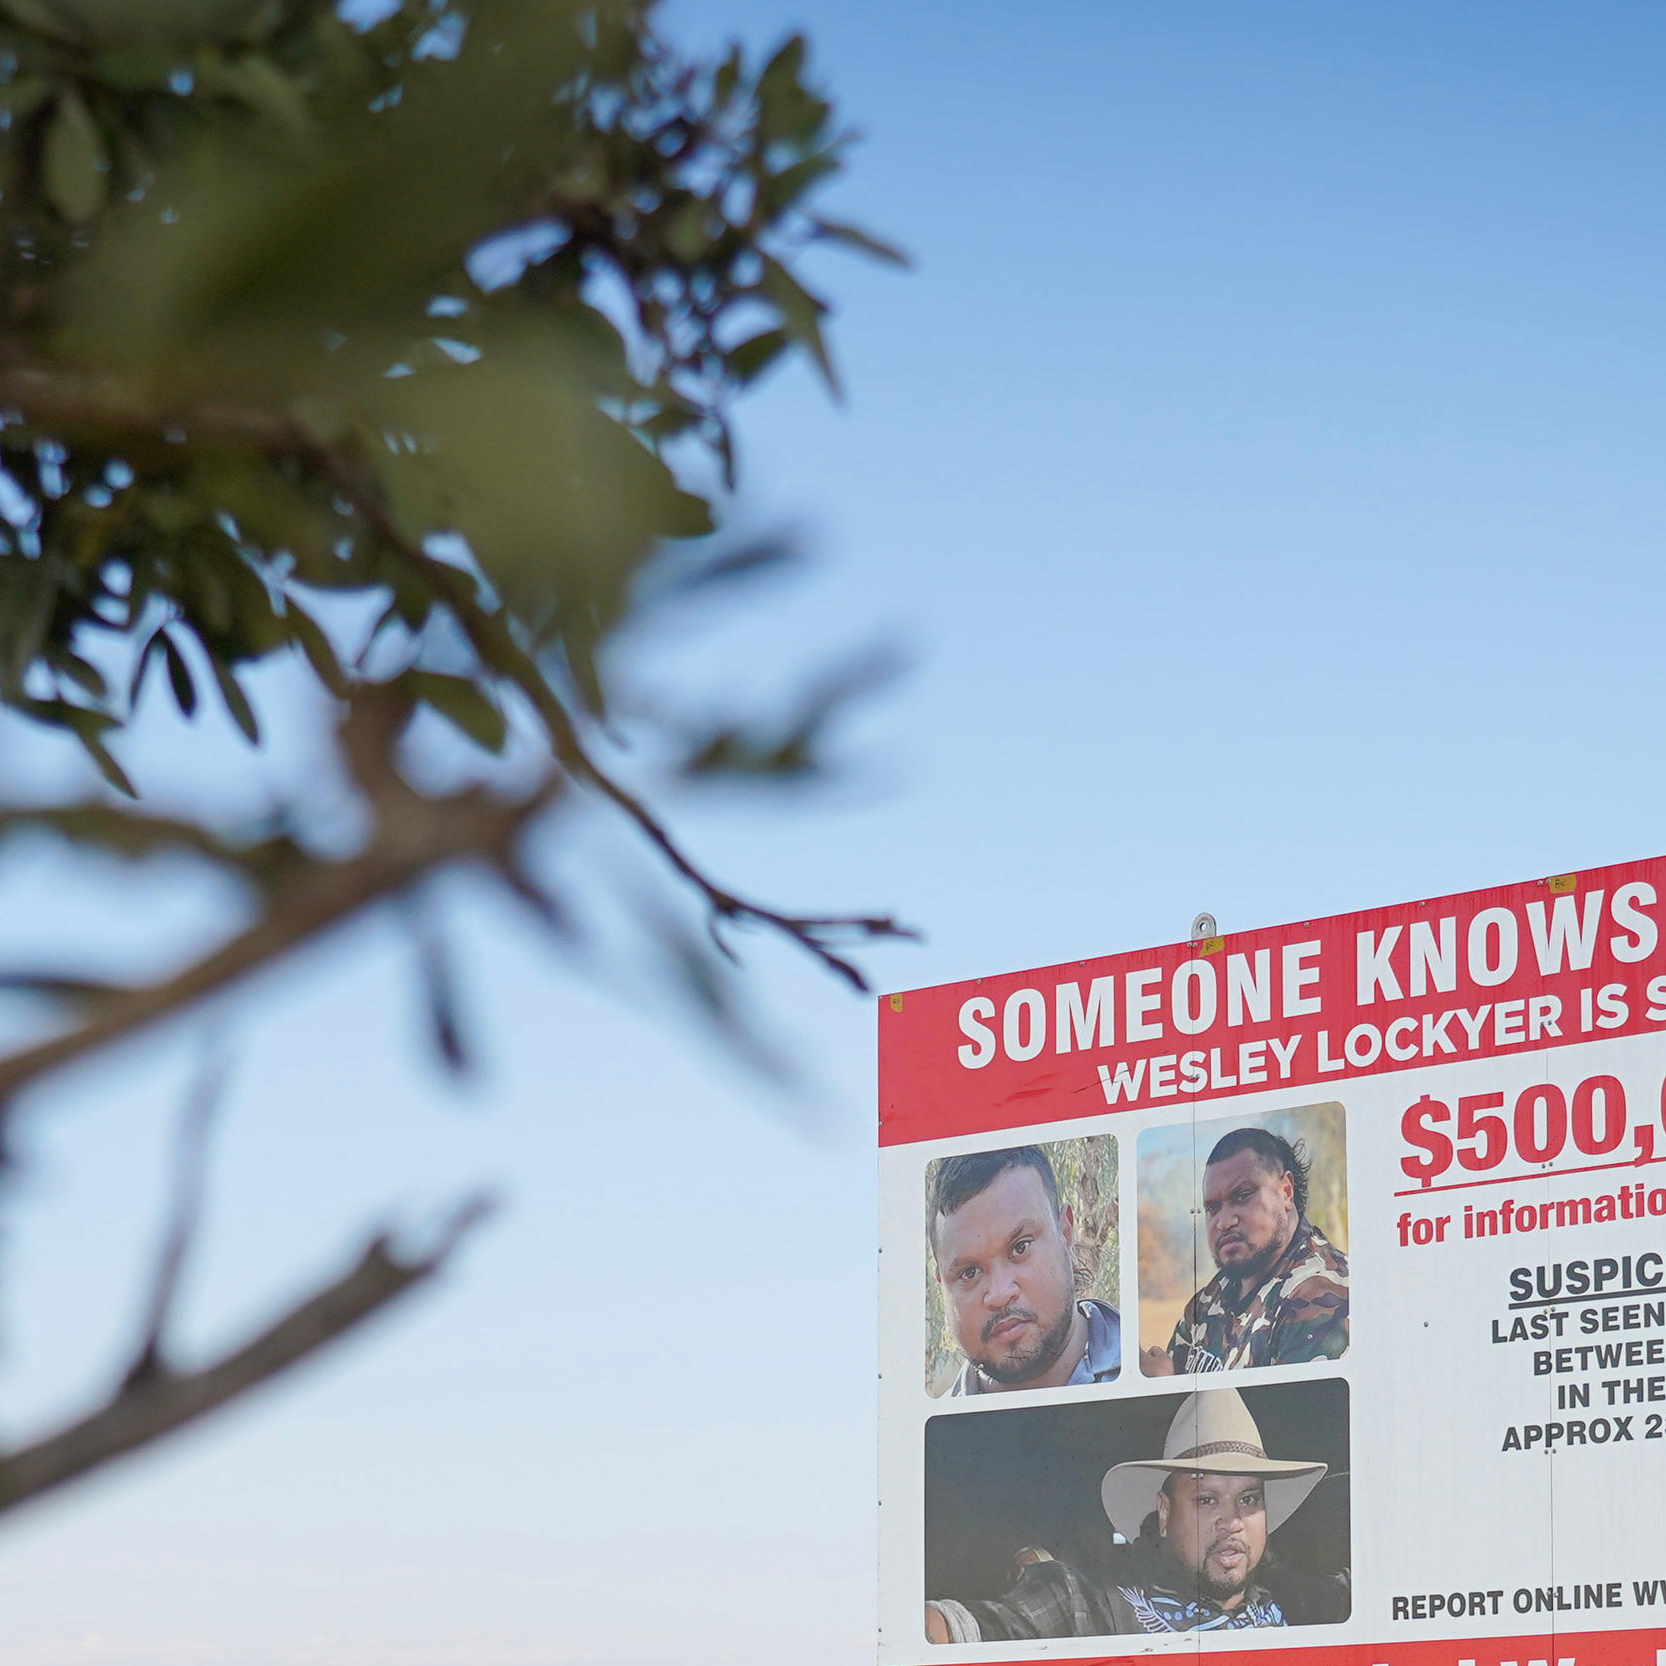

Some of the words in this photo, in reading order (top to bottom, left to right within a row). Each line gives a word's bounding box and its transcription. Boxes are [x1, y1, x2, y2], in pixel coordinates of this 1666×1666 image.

[957, 940, 1321, 1070] SOMEONE
[1356, 881, 1658, 1006] KNOWS
[1097, 1034, 1302, 1105] WESLEY
[1317, 994, 1563, 1073] LOCKYER
[1580, 983, 1629, 1032] IS
[1397, 1211, 1451, 1247] for
[1491, 1312, 1569, 1344] LAST
[1580, 1301, 1665, 1334] SEEN
[1557, 1383, 1590, 1410] IN
[1602, 1376, 1666, 1405] THE
[1501, 1415, 1634, 1452] APPROX
[1392, 1590, 1504, 1620] REPORT
[1513, 1582, 1623, 1614] ONLINE
